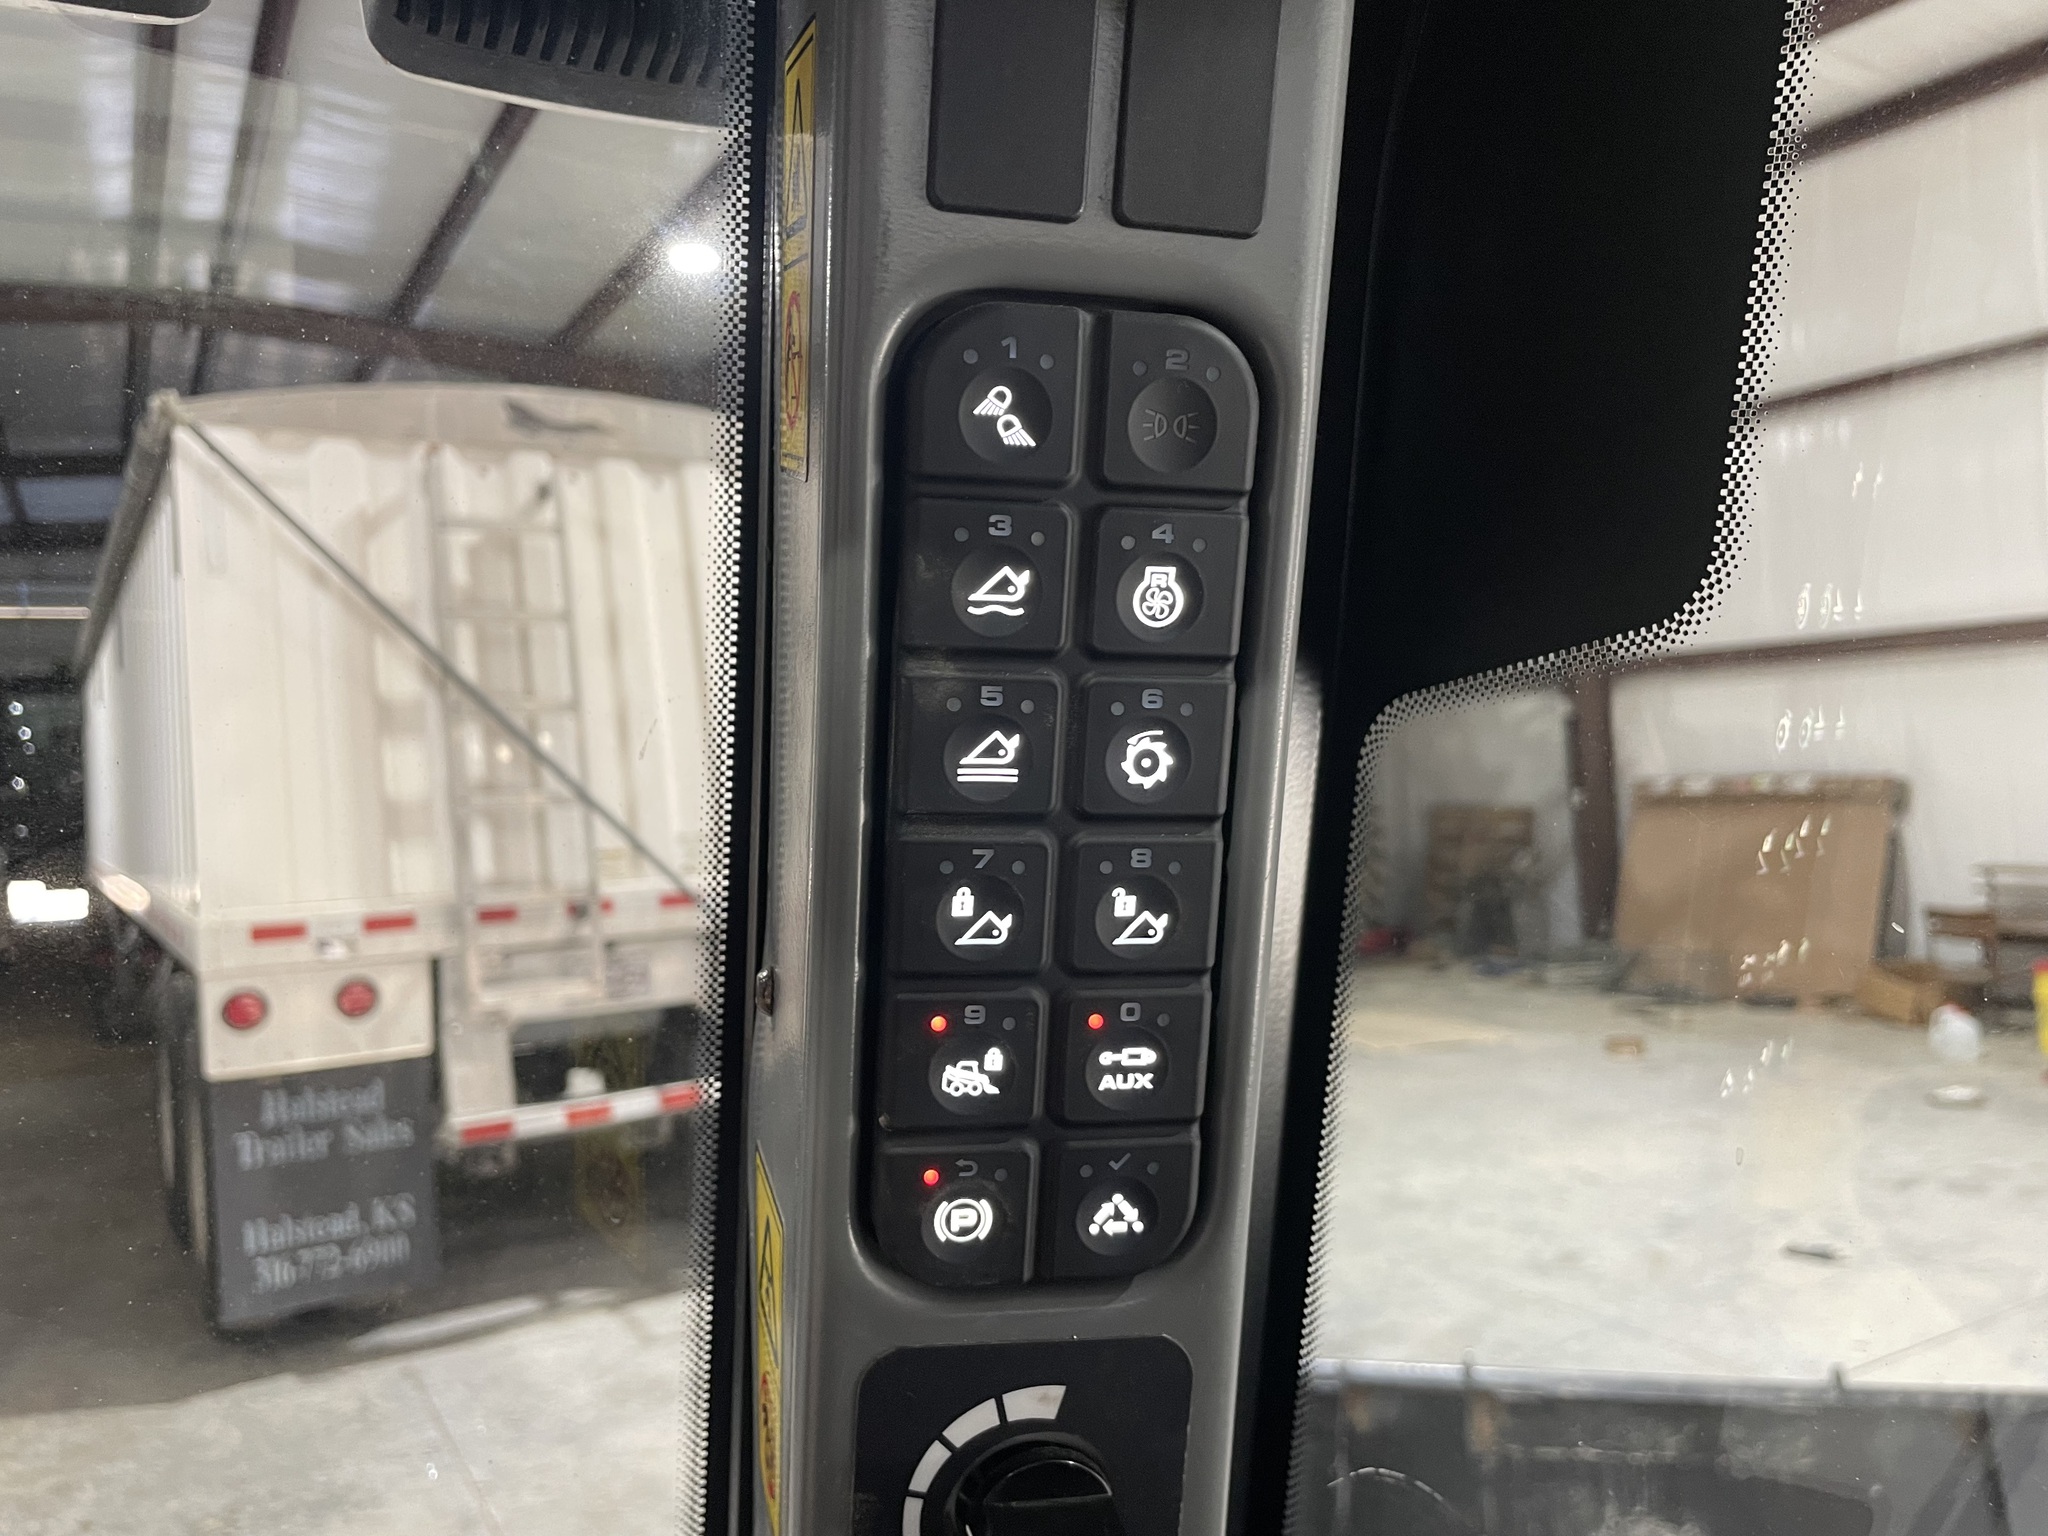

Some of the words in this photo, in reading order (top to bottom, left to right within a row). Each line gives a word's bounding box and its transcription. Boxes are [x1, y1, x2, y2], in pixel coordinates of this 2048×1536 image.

[1001, 336, 1018, 359] 1
[1165, 349, 1191, 371] 2
[988, 514, 1013, 537] 3
[1151, 523, 1175, 544] 4
[980, 685, 1004, 707] 5
[1141, 688, 1164, 709] 6
[972, 848, 995, 869] 7
[1130, 848, 1153, 869] 8
[963, 1004, 987, 1025] 9
[1097, 1072, 1155, 1091] AUX
[260, 1077, 384, 1129] Halstead
[234, 1129, 334, 1171] Trailer
[343, 1116, 415, 1153] Sales
[370, 1193, 416, 1234] KS
[950, 1208, 979, 1232] P
